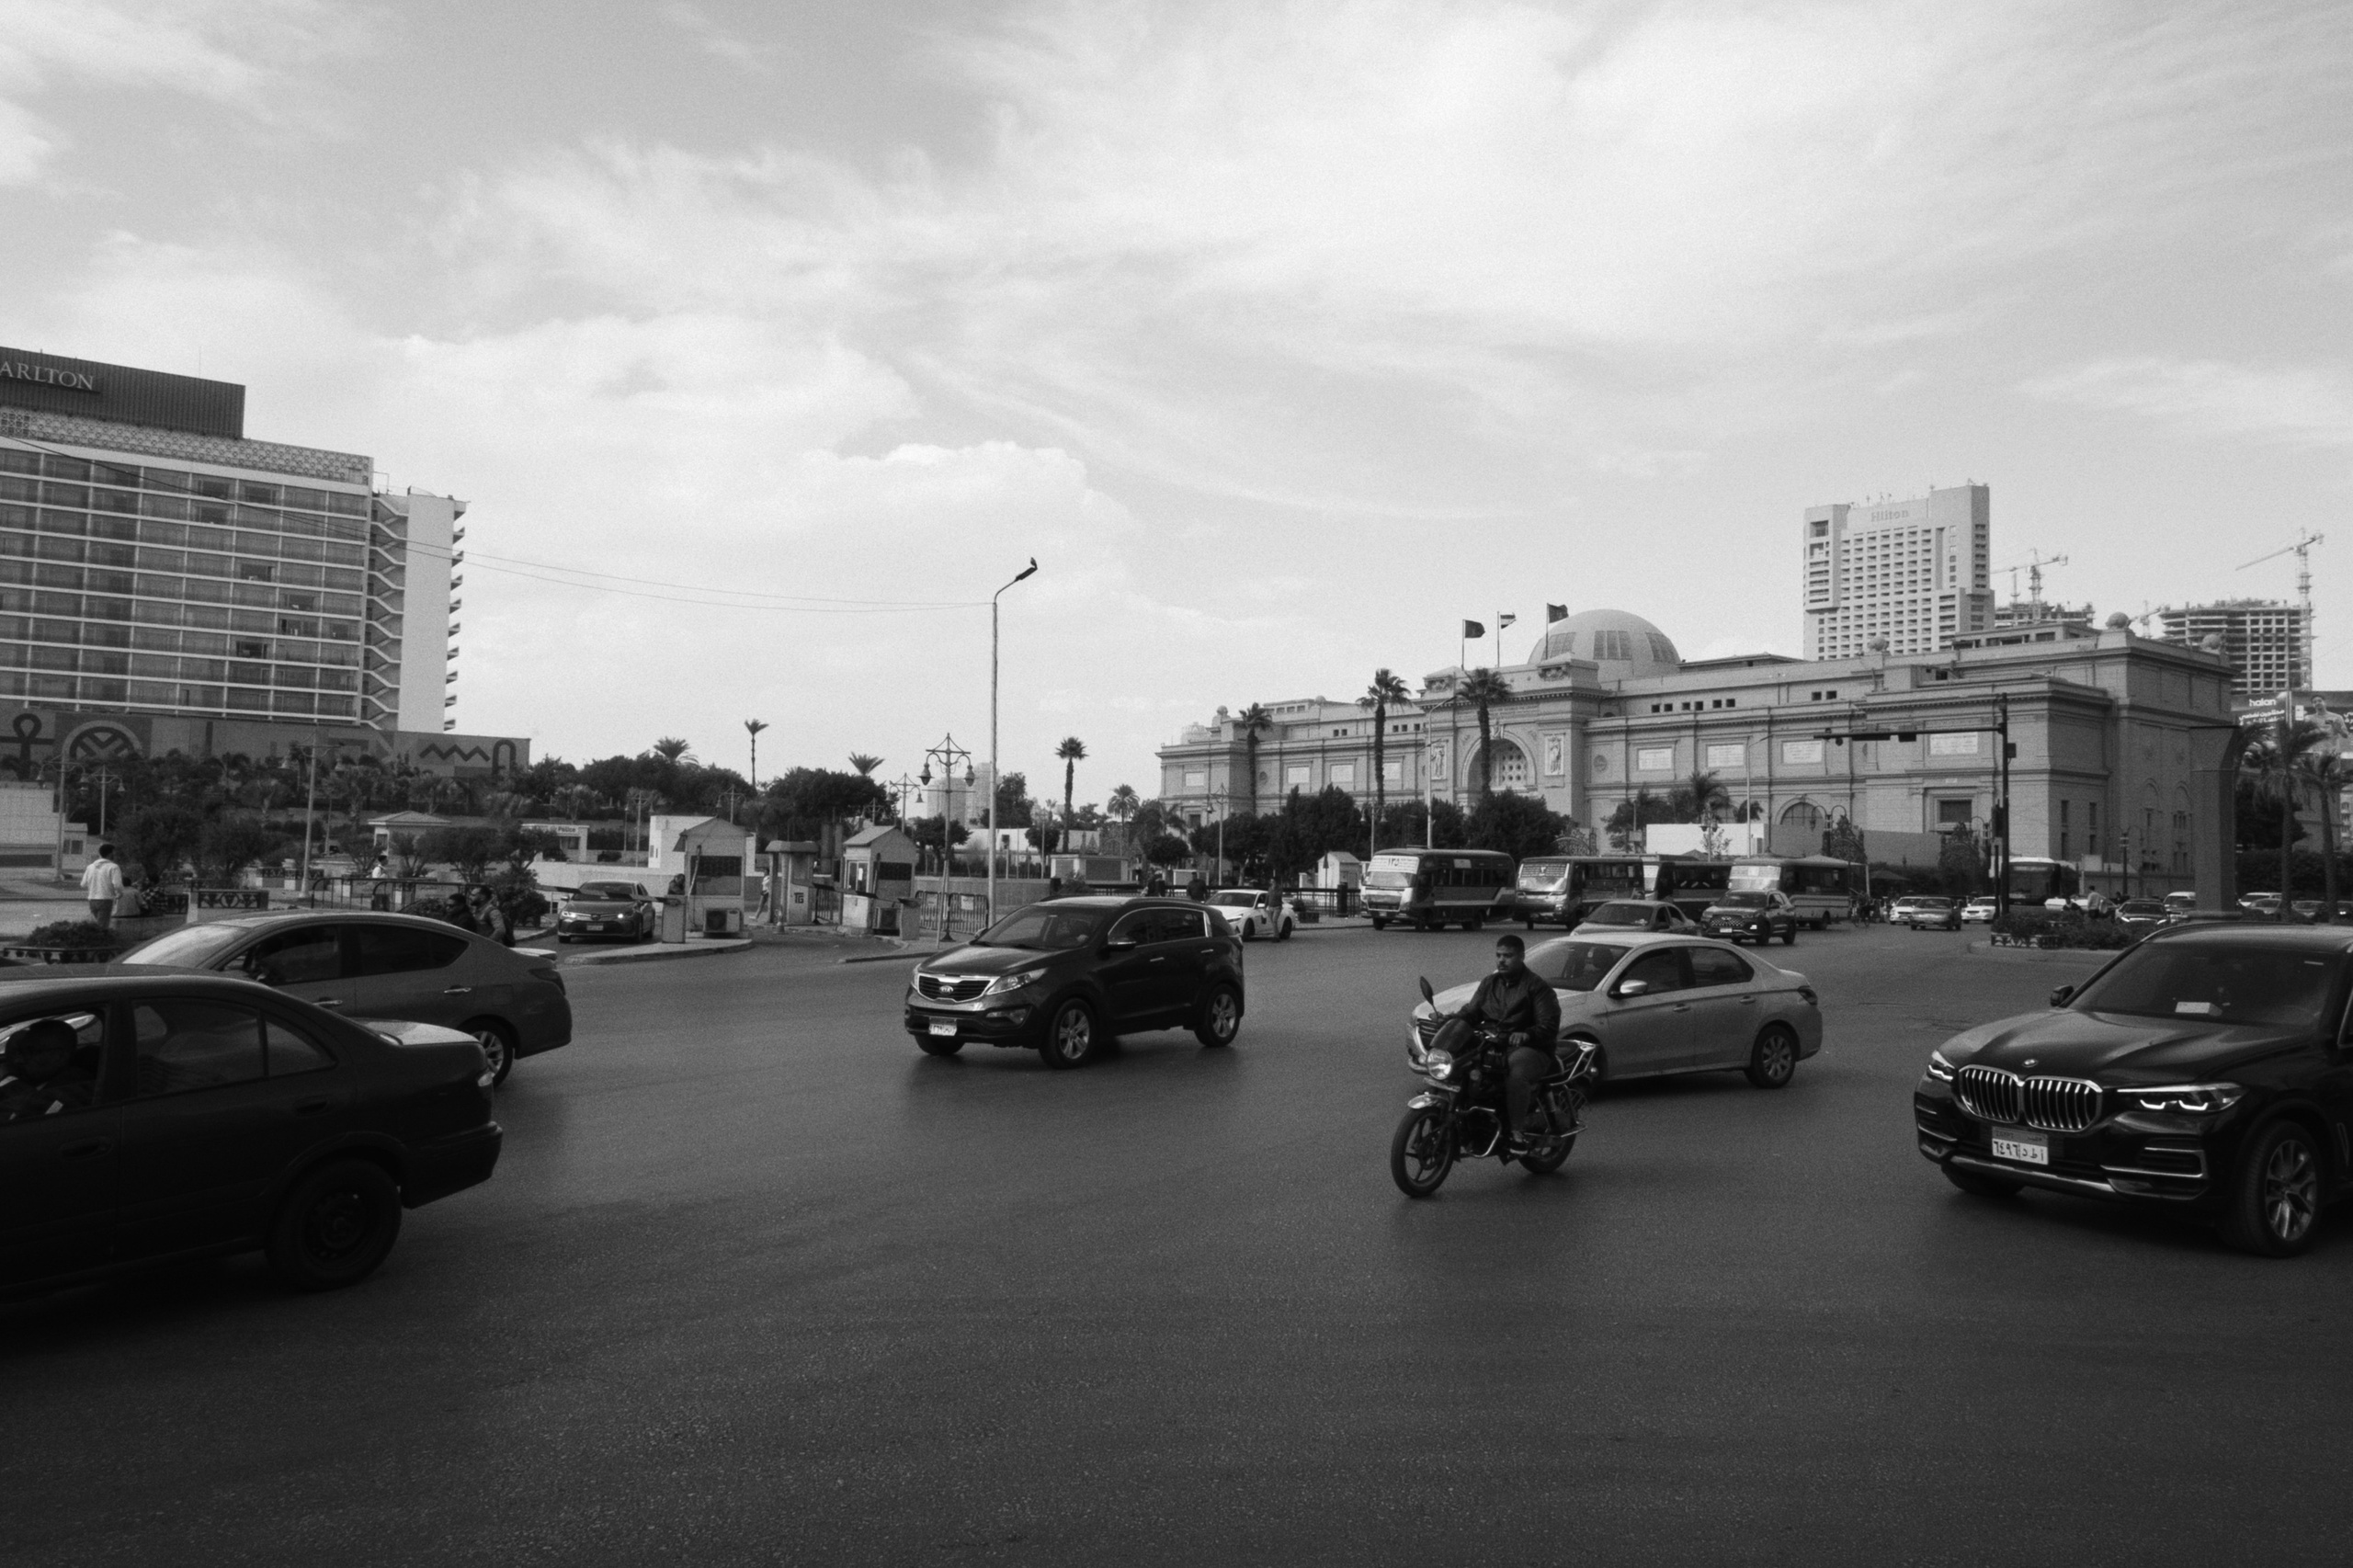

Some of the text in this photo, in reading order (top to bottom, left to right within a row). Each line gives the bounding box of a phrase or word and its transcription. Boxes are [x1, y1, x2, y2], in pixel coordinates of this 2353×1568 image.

[0, 361, 95, 391] ARLTON
[1871, 509, 1909, 522] Hilton
[2249, 698, 2277, 707] halan
